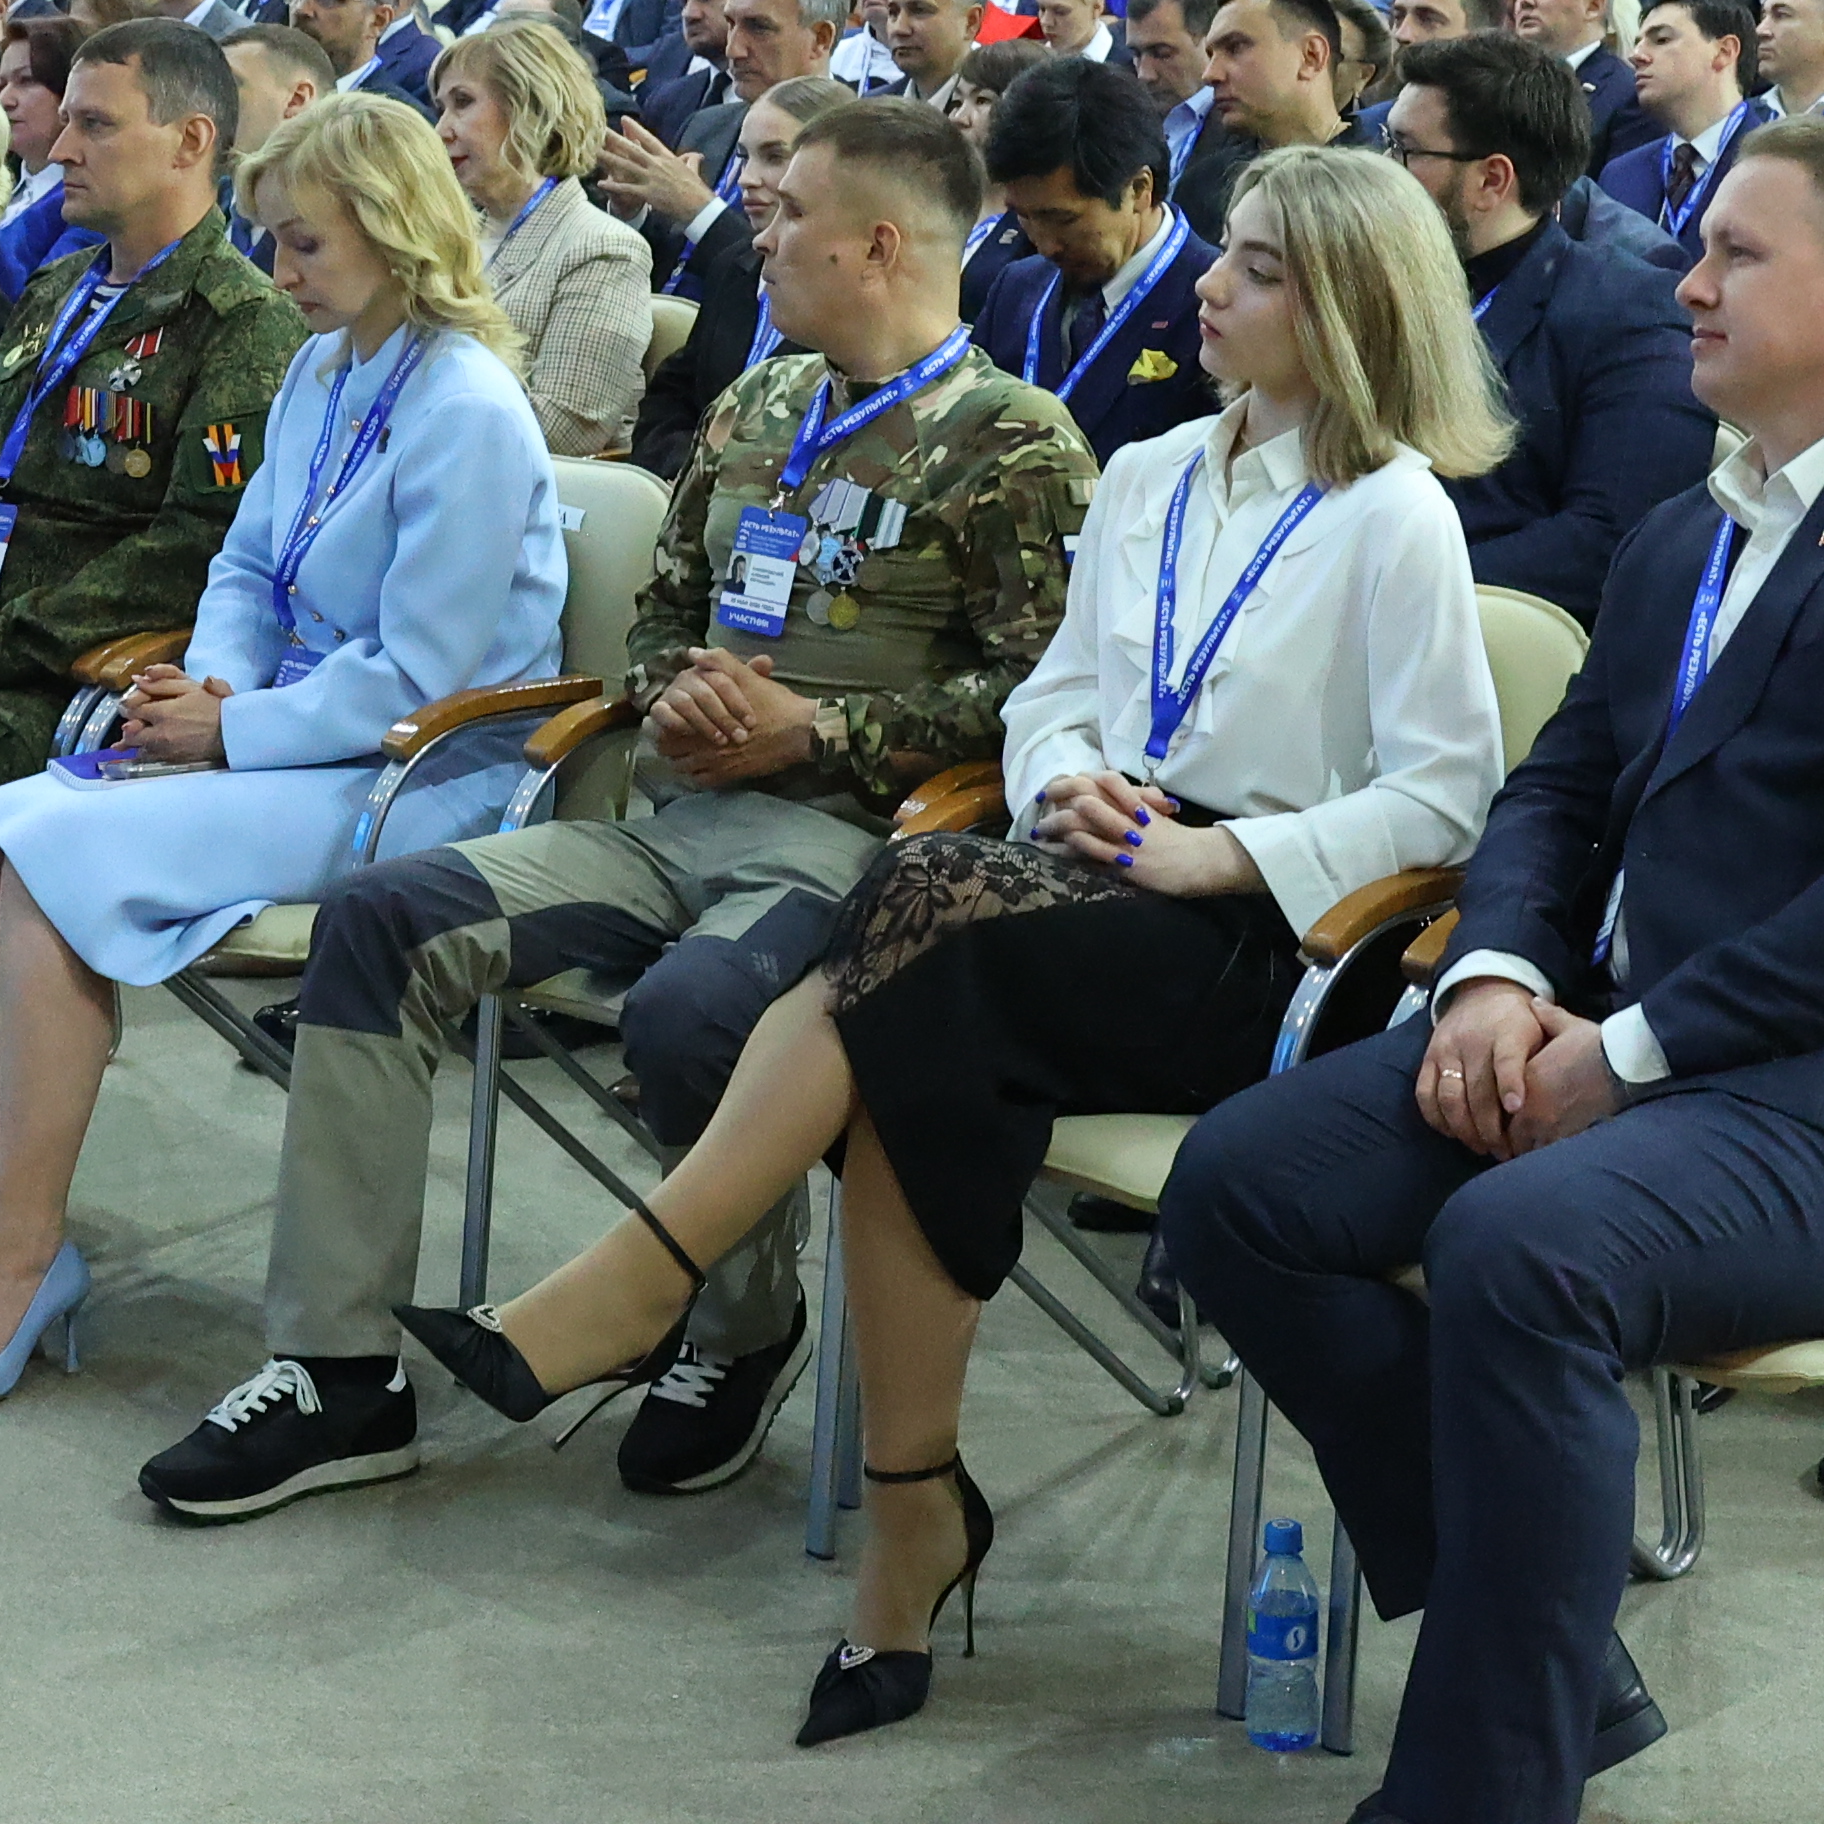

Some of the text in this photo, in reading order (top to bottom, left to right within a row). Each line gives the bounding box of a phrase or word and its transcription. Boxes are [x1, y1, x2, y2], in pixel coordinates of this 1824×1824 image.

[843, 389, 899, 429] РЕЗУЛЬТАТ»
[1244, 494, 1313, 584] «ЕСТЬ РЕЗУЛЬТАТ»
[1158, 596, 1171, 699] «ЕСТЬ РЕЗУЛЬТАТ»
[1176, 608, 1232, 706] «ЕСТЬ РЕЗУЛЬТАТ»
[1692, 611, 1709, 648] «ЕСТЬ
